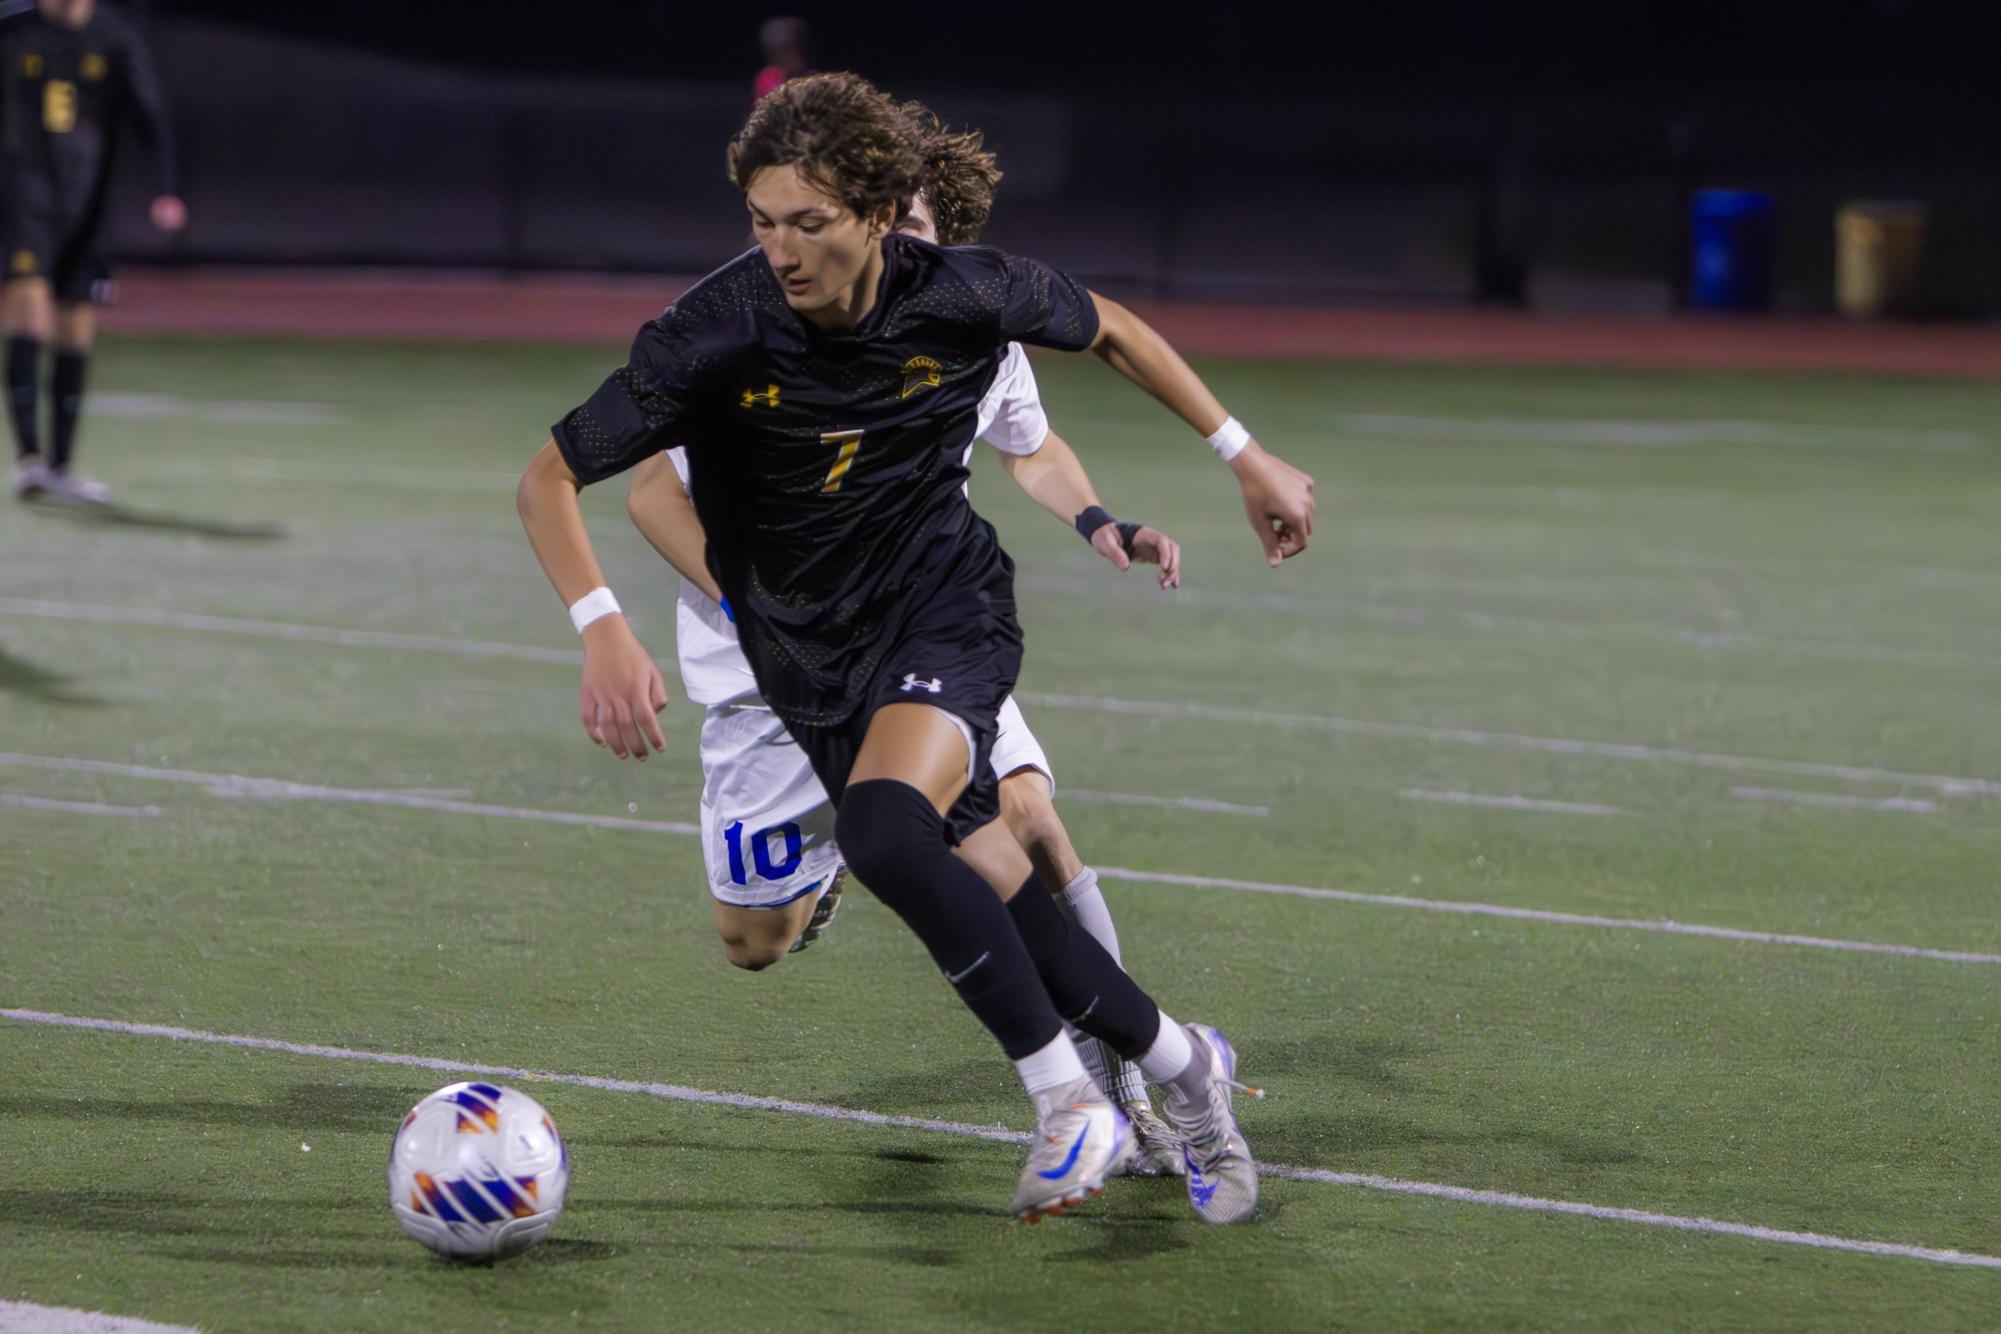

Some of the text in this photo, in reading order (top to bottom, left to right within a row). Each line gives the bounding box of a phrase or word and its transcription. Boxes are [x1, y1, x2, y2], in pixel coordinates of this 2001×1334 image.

[42, 79, 76, 133] 6
[820, 429, 865, 493] 7
[724, 820, 802, 886] 10
